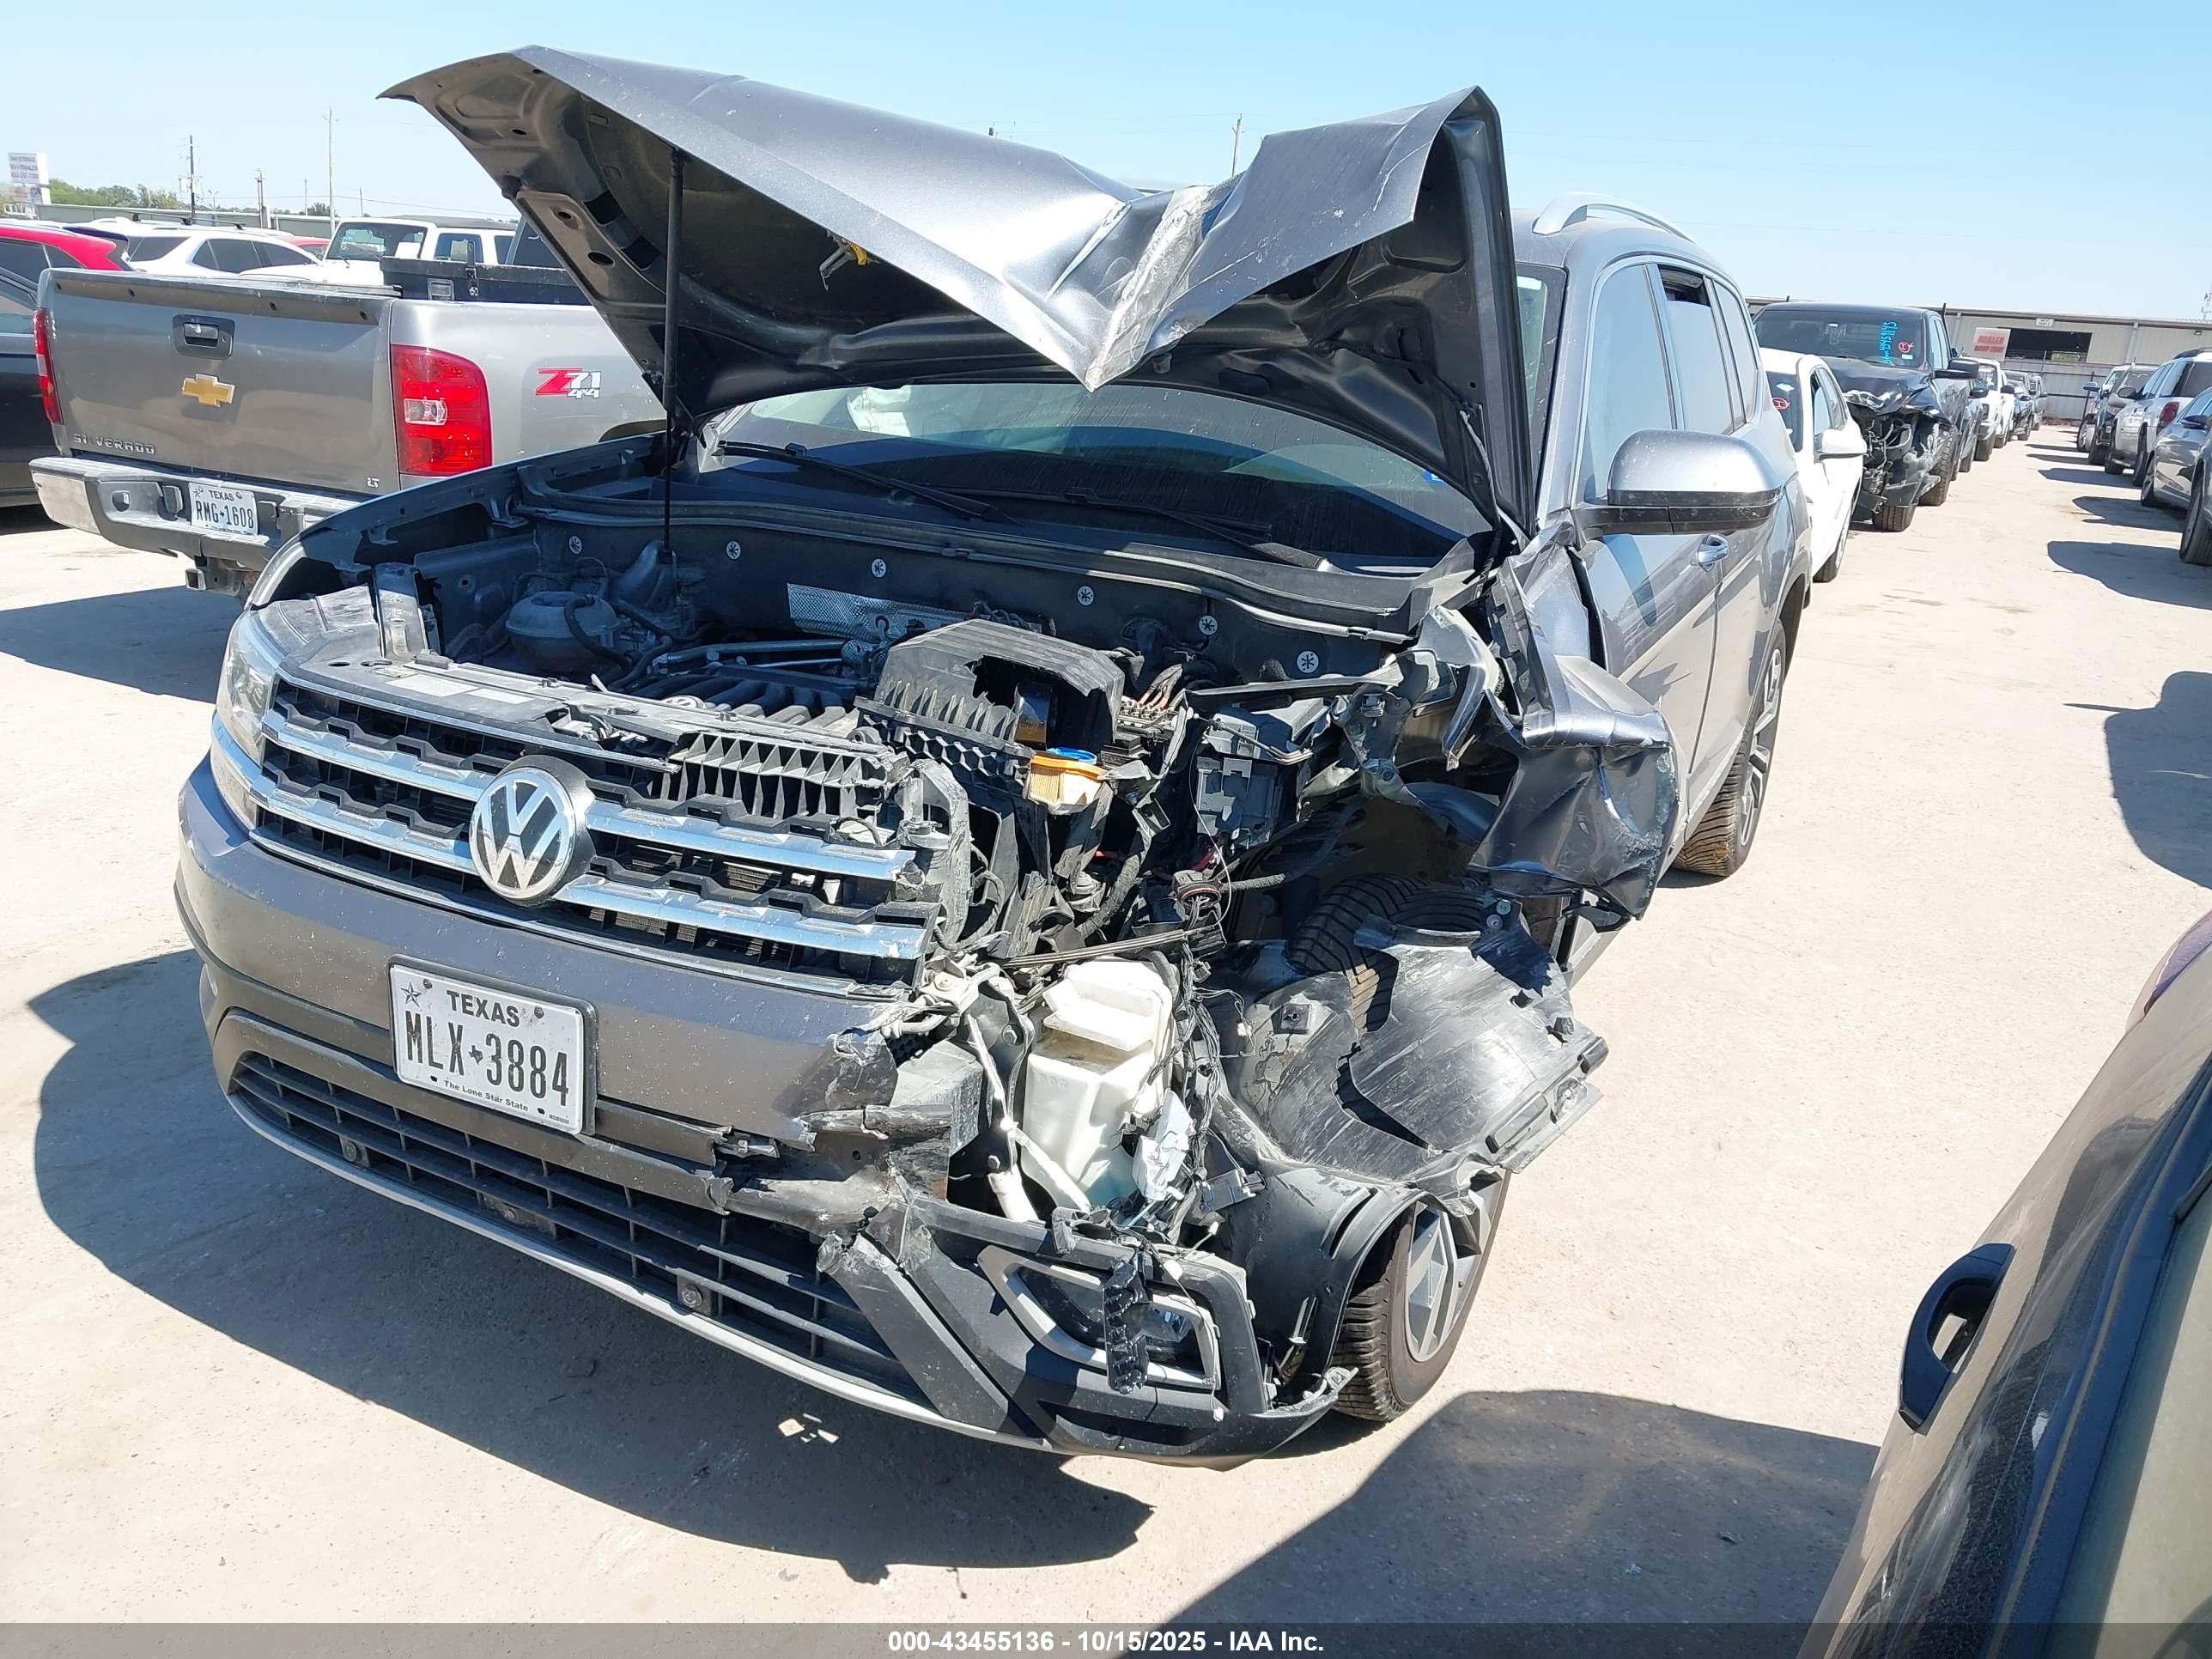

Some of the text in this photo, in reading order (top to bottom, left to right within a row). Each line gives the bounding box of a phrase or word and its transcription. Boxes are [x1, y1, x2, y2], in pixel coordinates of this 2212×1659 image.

[536, 367, 602, 397] Z71
[74, 433, 155, 454] SIVERADO
[208, 489, 234, 501] TEXAS
[447, 990, 520, 1027] TEXAS
[443, 1079, 529, 1112] The Lone Star State
